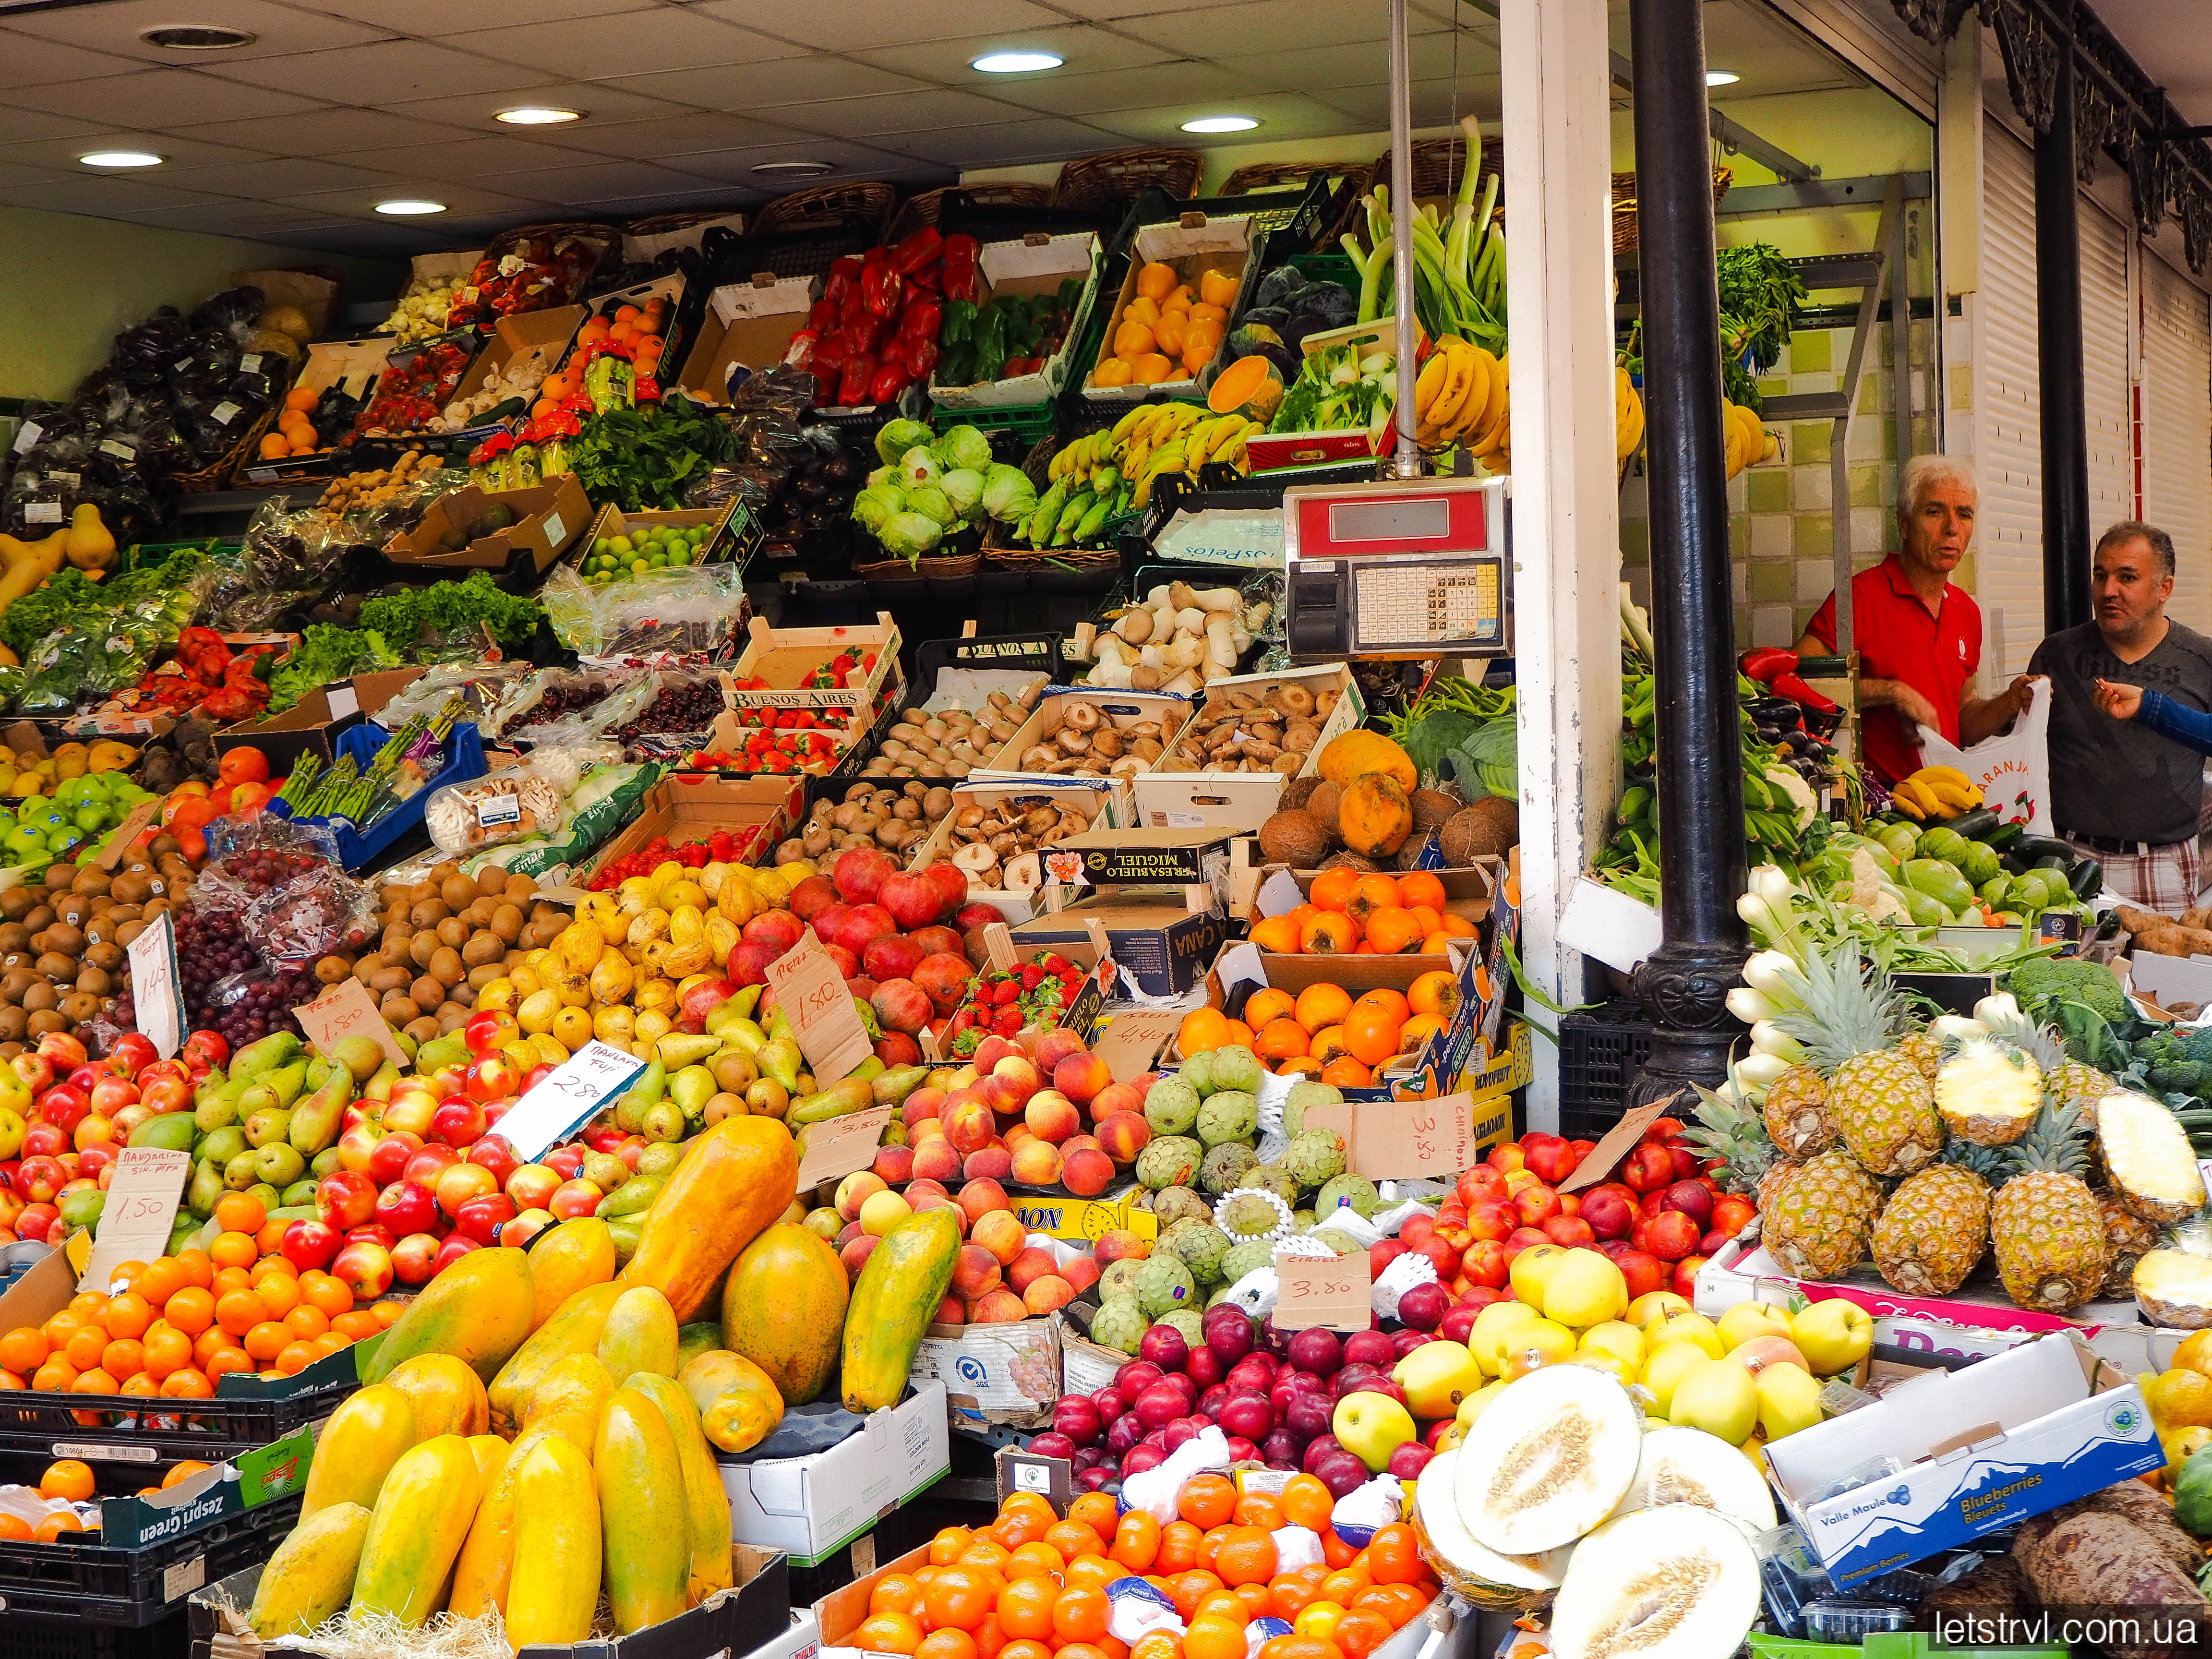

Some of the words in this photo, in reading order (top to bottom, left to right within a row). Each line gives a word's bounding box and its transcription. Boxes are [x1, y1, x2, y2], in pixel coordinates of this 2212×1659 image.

[733, 693, 800, 709] BUENOS
[807, 692, 857, 706] AIRES
[844, 758, 855, 775] todo
[1116, 855, 1178, 865] MIGUEL
[1175, 931, 1216, 959] CAÑA
[1453, 1031, 1471, 1070] BOUQUET
[115, 1198, 163, 1225] 1.50
[909, 1444, 922, 1458] GOLDEN
[921, 1435, 930, 1448] ROSE
[1960, 1473, 2043, 1514] Blueberries
[183, 1495, 224, 1530] Zespri
[1820, 1511, 1850, 1527] Valle
[1852, 1498, 1887, 1517] Maule
[1964, 1502, 2007, 1525] Bleuets
[139, 1517, 181, 1543] Green
[1840, 1563, 1878, 1583] Premium
[1879, 1551, 1909, 1569] Berries
